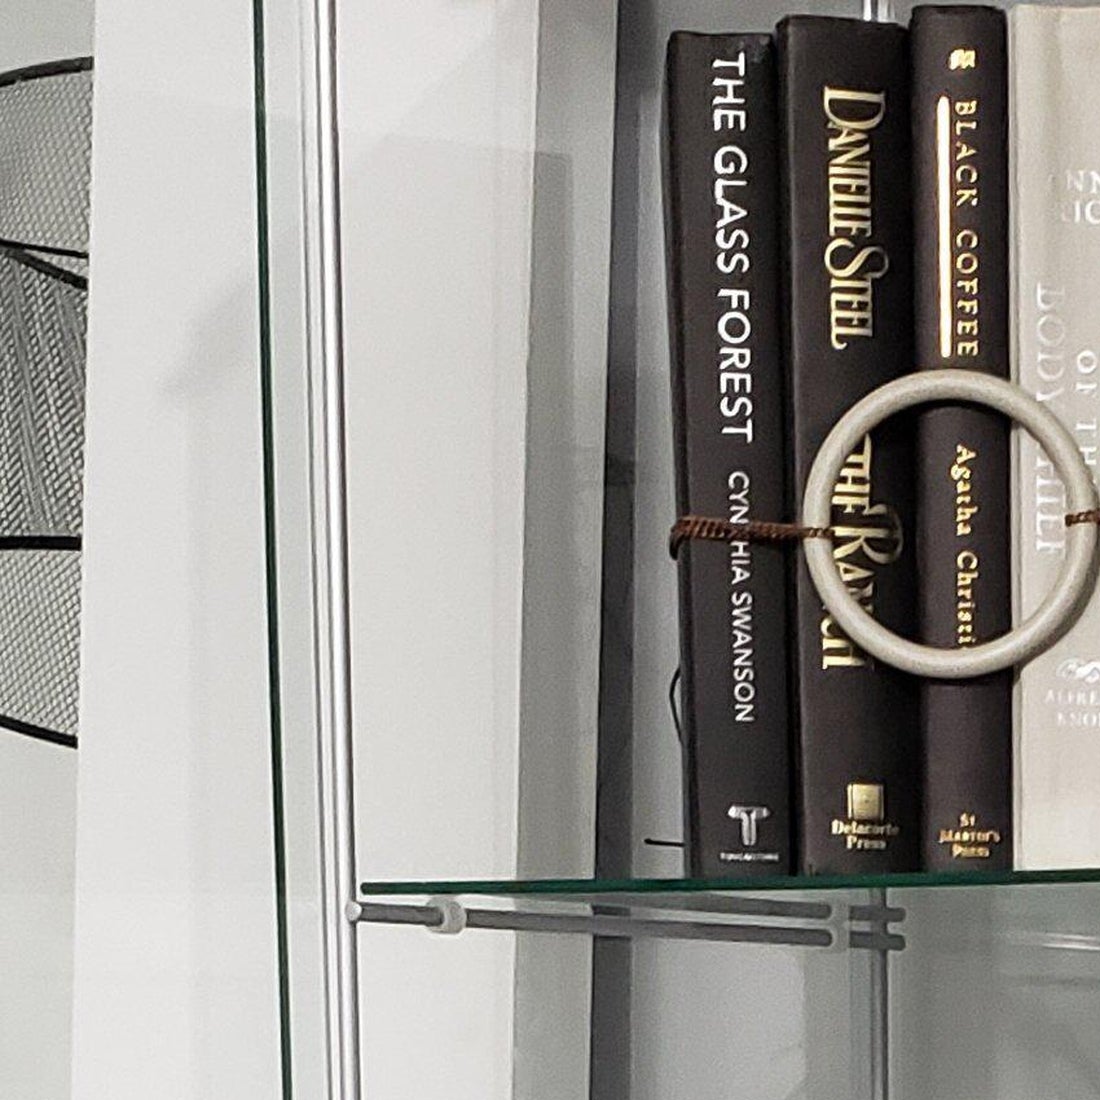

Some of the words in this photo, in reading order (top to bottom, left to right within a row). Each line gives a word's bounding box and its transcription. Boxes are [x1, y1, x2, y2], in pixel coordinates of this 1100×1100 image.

[711, 51, 746, 132] THE
[823, 85, 886, 237] DANIELLE
[954, 99, 979, 207] BLACK
[713, 144, 750, 274] GLASS
[823, 237, 889, 350] STEEL
[955, 228, 979, 358] COFFEE
[716, 287, 754, 444] FOREST
[950, 444, 979, 537] Agatha
[1075, 418, 1098, 485] TH
[727, 471, 751, 585] CYNHIA
[956, 550, 979, 650] Christi
[731, 591, 756, 723] SWANSON
[831, 819, 900, 836] Delacorte
[846, 835, 888, 850] Press
